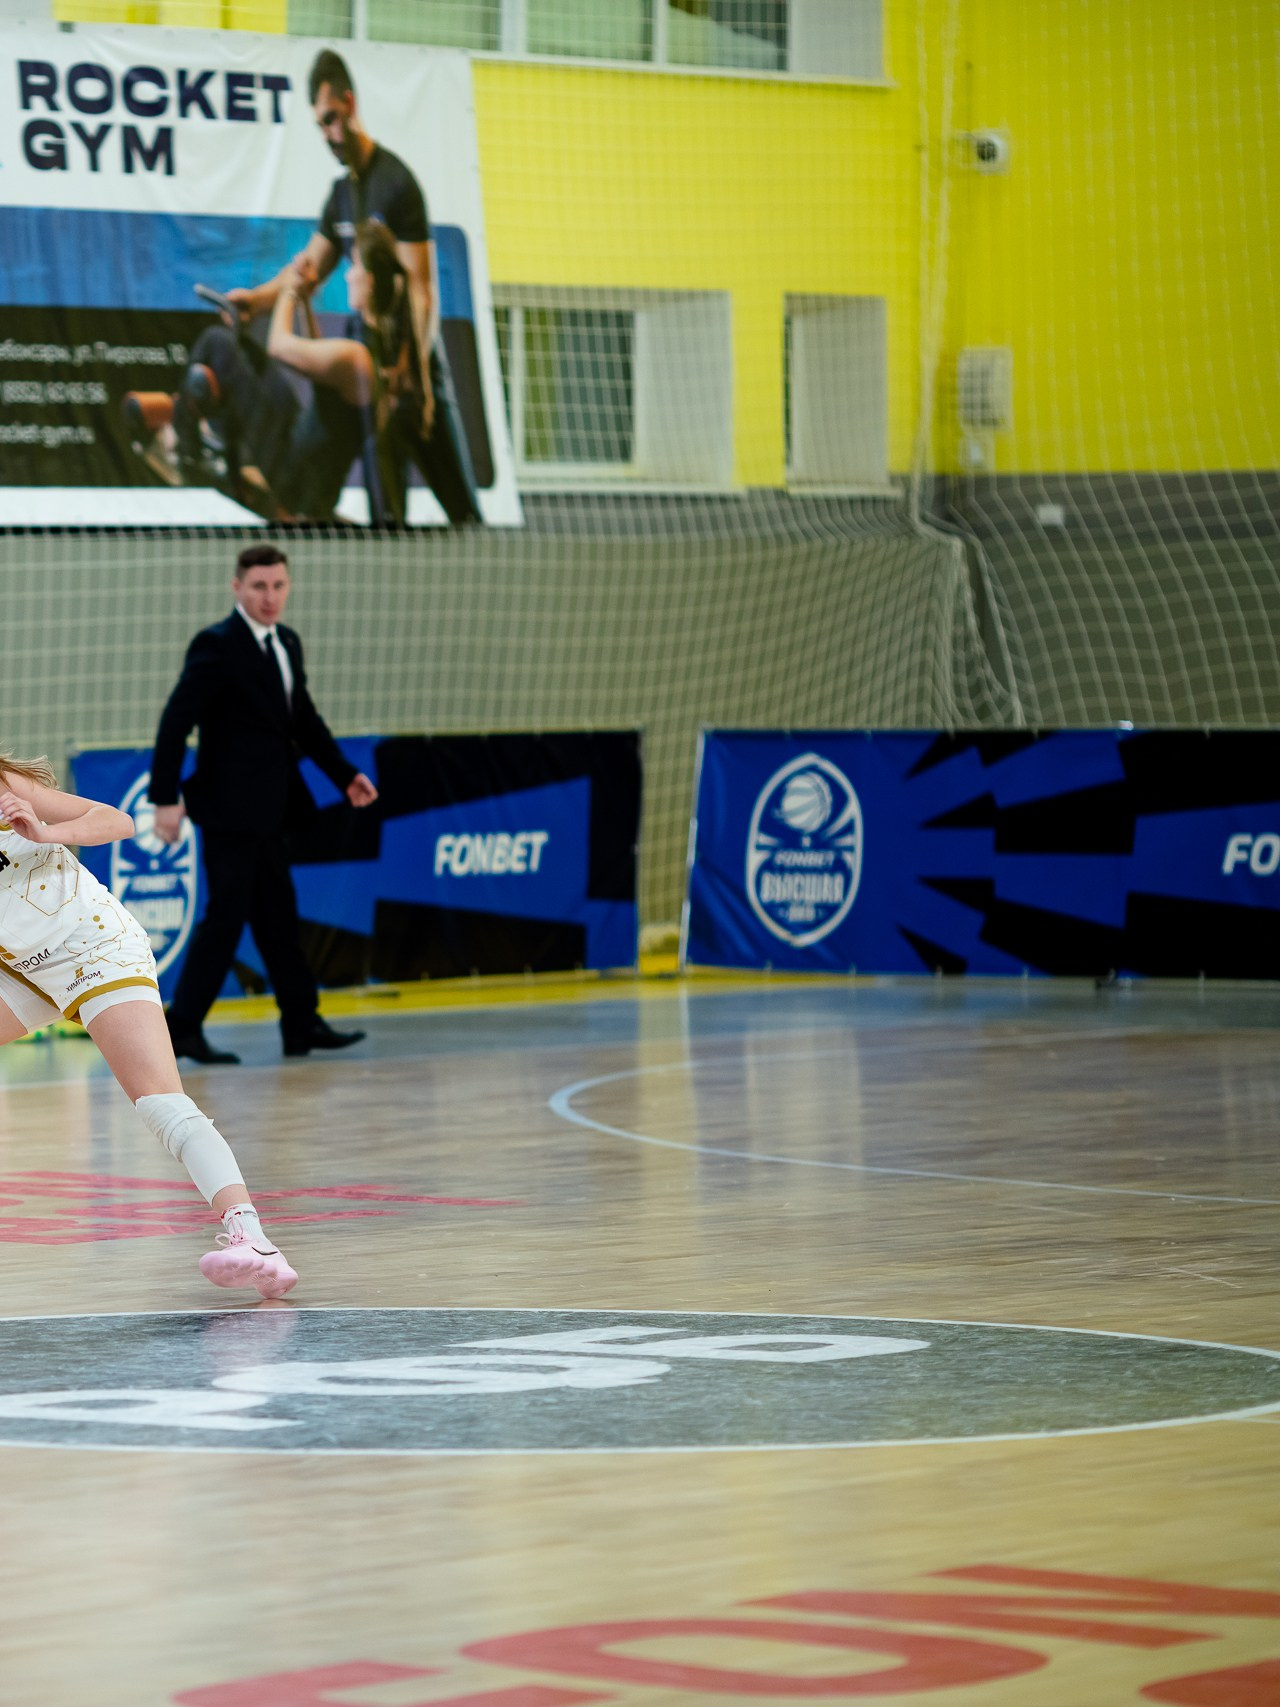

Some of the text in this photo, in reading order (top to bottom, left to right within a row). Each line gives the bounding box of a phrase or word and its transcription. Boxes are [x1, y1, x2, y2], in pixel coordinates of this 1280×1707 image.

[17, 59, 292, 123] ROCKET
[21, 118, 176, 176] GYM
[434, 831, 549, 876] FONBET
[1222, 833, 1280, 875] FO
[761, 872, 845, 903] ВЫСШАЯ
[66, 970, 101, 993] ХИМПРОМ
